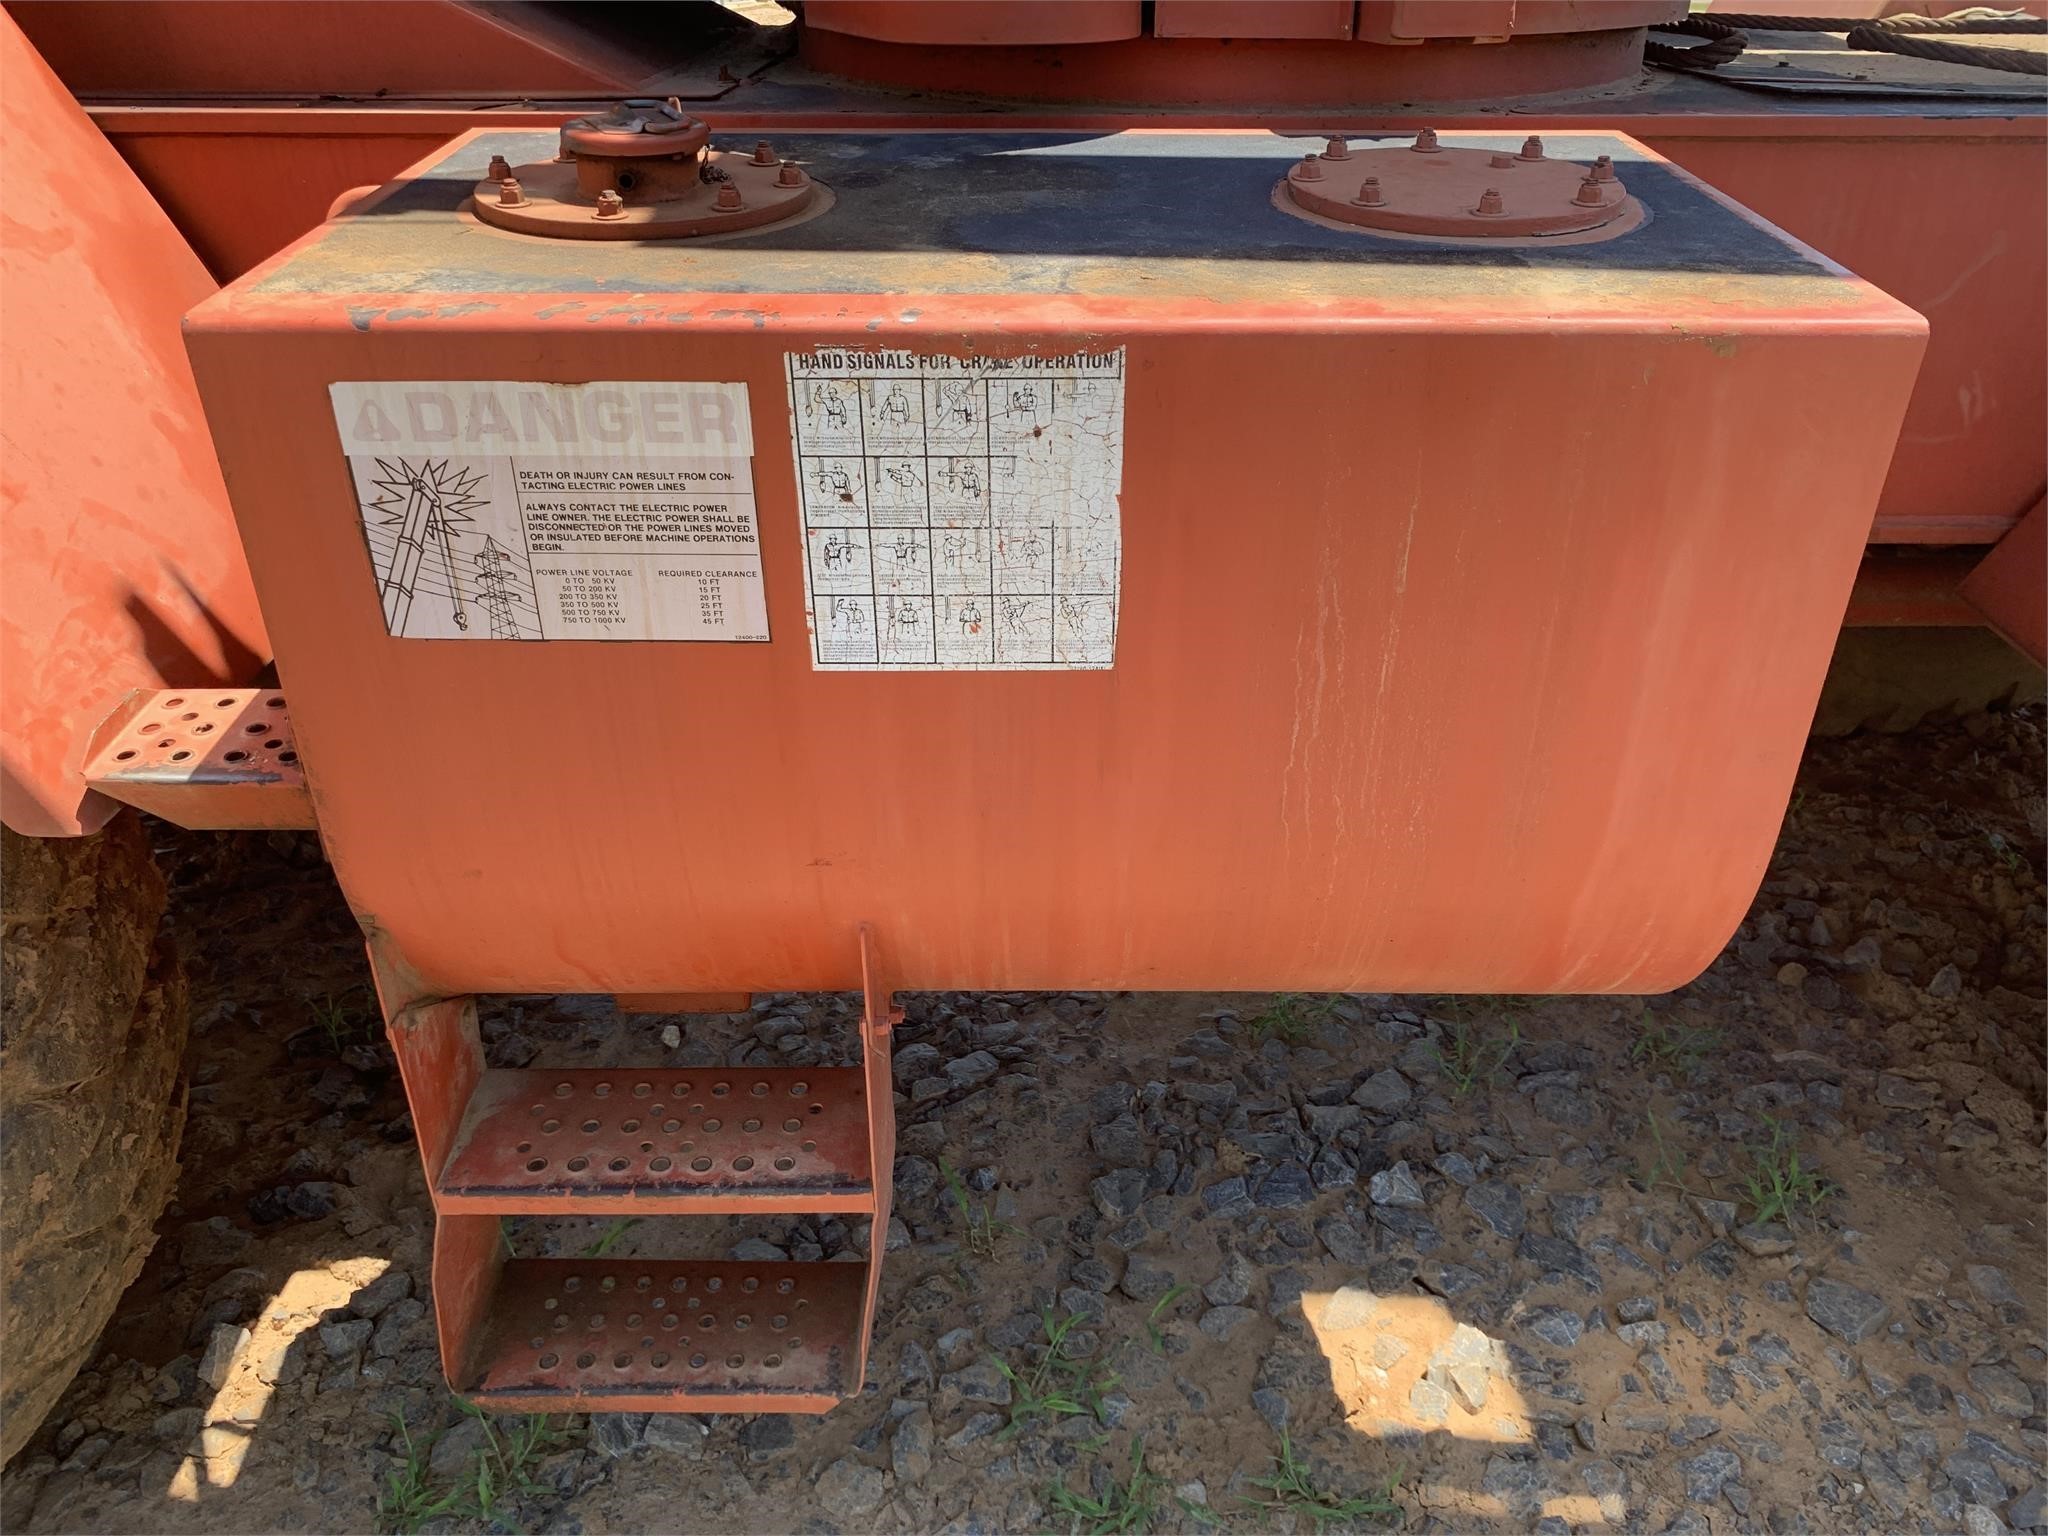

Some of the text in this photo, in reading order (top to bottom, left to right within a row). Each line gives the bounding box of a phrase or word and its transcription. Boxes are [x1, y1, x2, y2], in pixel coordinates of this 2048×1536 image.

[800, 352, 843, 369] HAND
[848, 353, 914, 369] SIGNALS
[920, 354, 951, 369] FOR
[404, 390, 737, 444] DANGER
[519, 471, 735, 481] DEATH OR INJURY CAN RESULT FROM CON-
[522, 482, 686, 491] TACTING ELECTRIC POWER LINES
[526, 503, 728, 512] ALWAYS CONTACT THE ELECTRIC POWER
[526, 514, 750, 523] LINE OWNER. THE ELECTRIC POWER SHALL BE
[528, 523, 751, 533] DISCONNECTED OR THE POWER LINES MOVED
[530, 533, 755, 543] OR INSULATED BEFORE MACHINE OPERATIONS
[532, 543, 565, 551] BEGIN.
[536, 569, 633, 577] POWER LINE VOLTAGE
[658, 570, 758, 578] REQUIRED CLEARANCE
